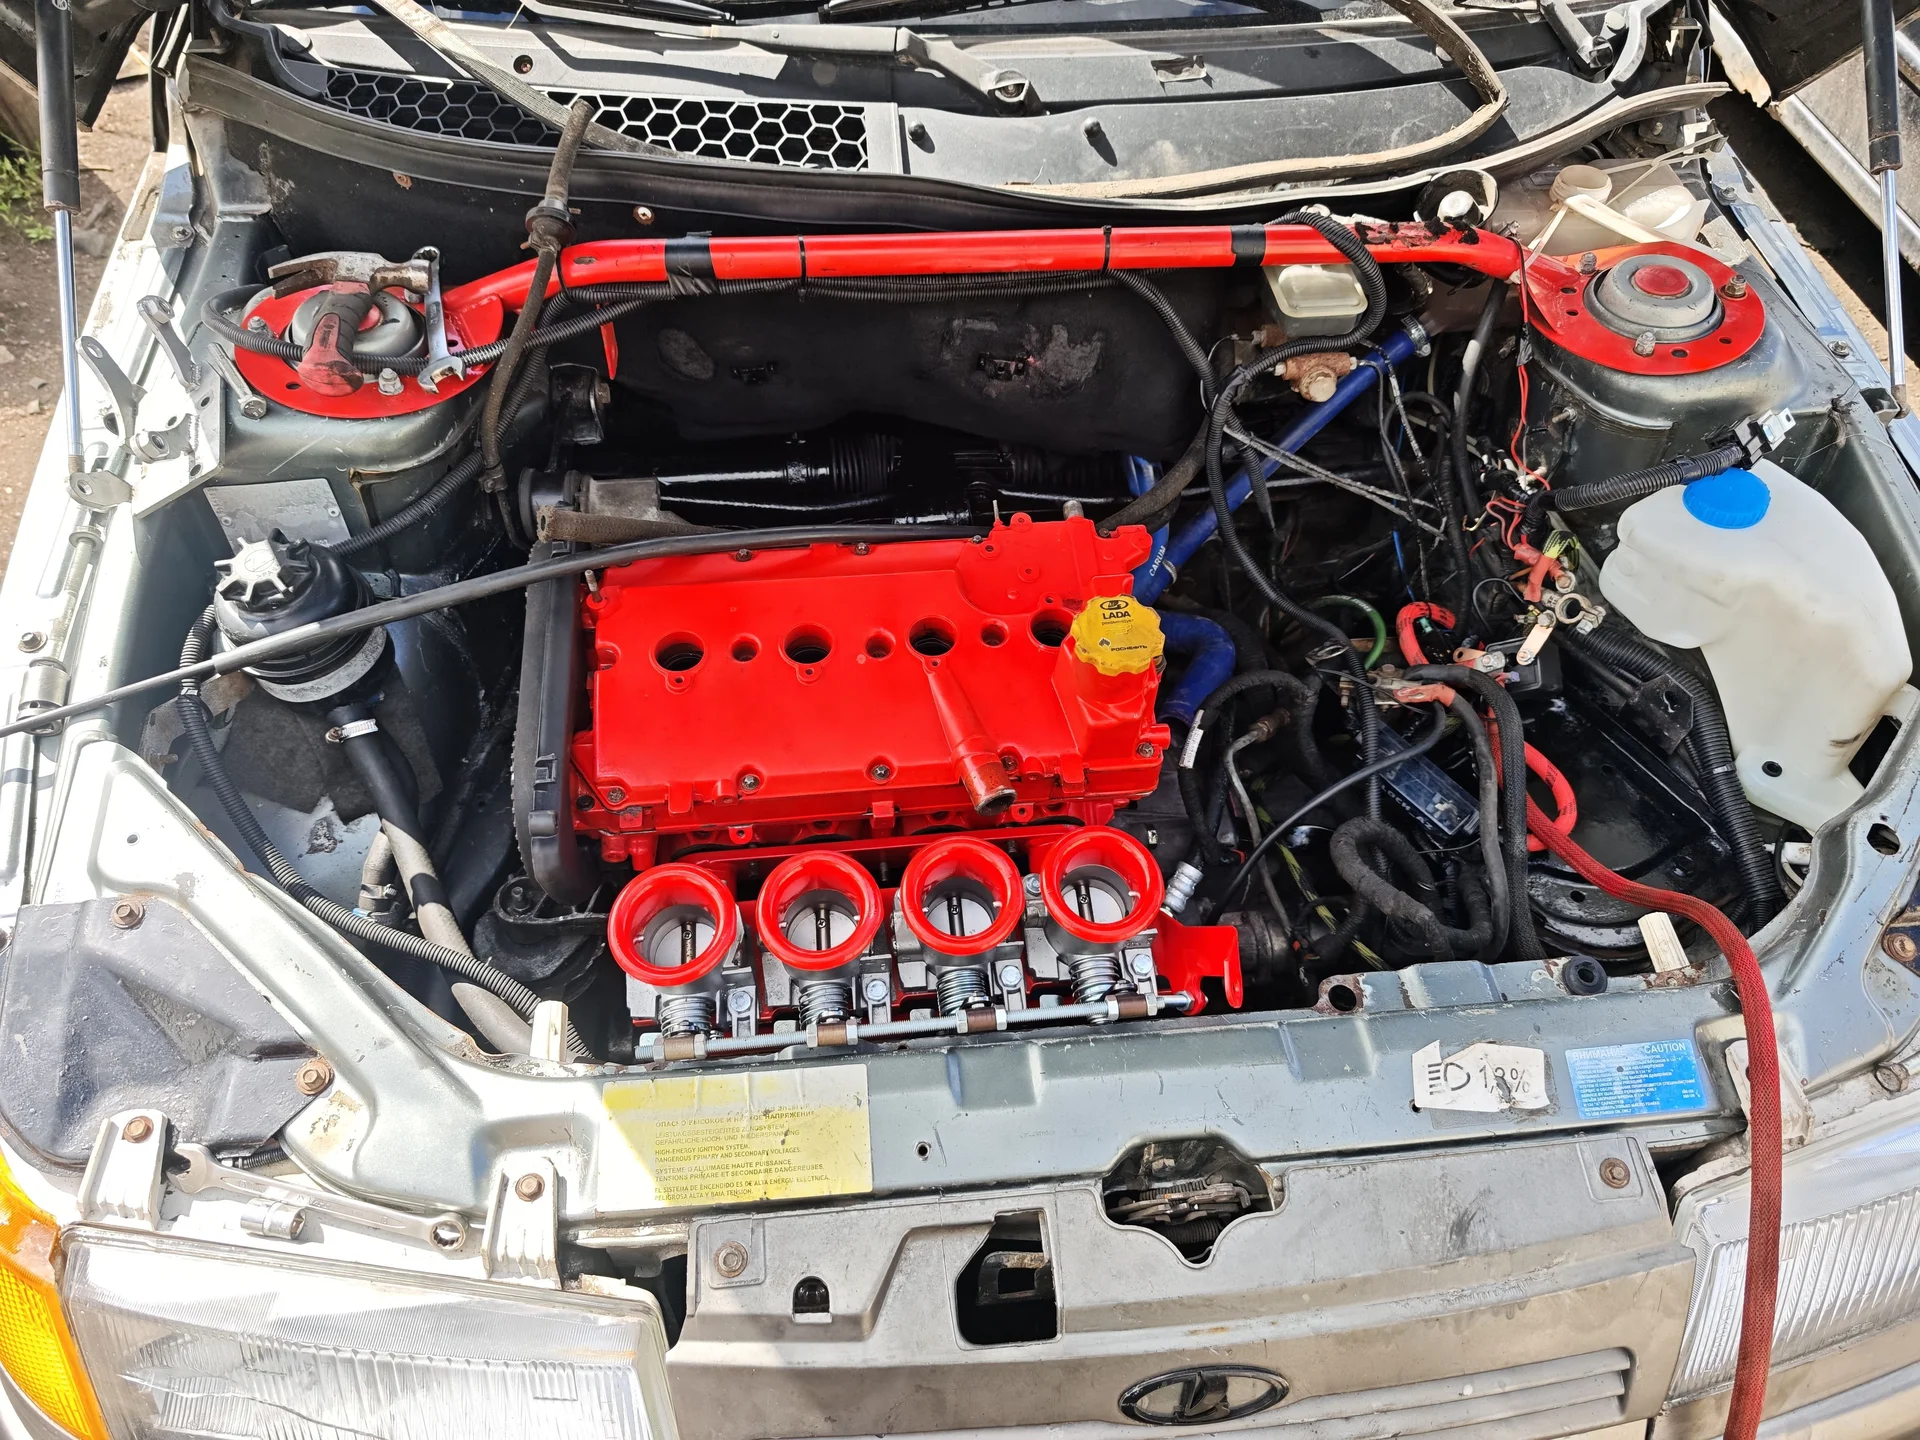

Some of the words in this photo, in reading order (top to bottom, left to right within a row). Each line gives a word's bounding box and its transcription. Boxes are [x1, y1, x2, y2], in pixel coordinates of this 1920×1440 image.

[1149, 545, 1166, 577] CARUM
[1102, 610, 1131, 620] LADA
[1573, 1047, 1627, 1060] ВНИМАНИЕ
[1644, 1042, 1686, 1054] CAUTION
[655, 1147, 695, 1155] HIGH-ENERGY
[656, 1174, 688, 1182] TENSIONS
[731, 1168, 773, 1176] SECONDAIRE
[700, 1182, 734, 1190] ENCENDIDO
